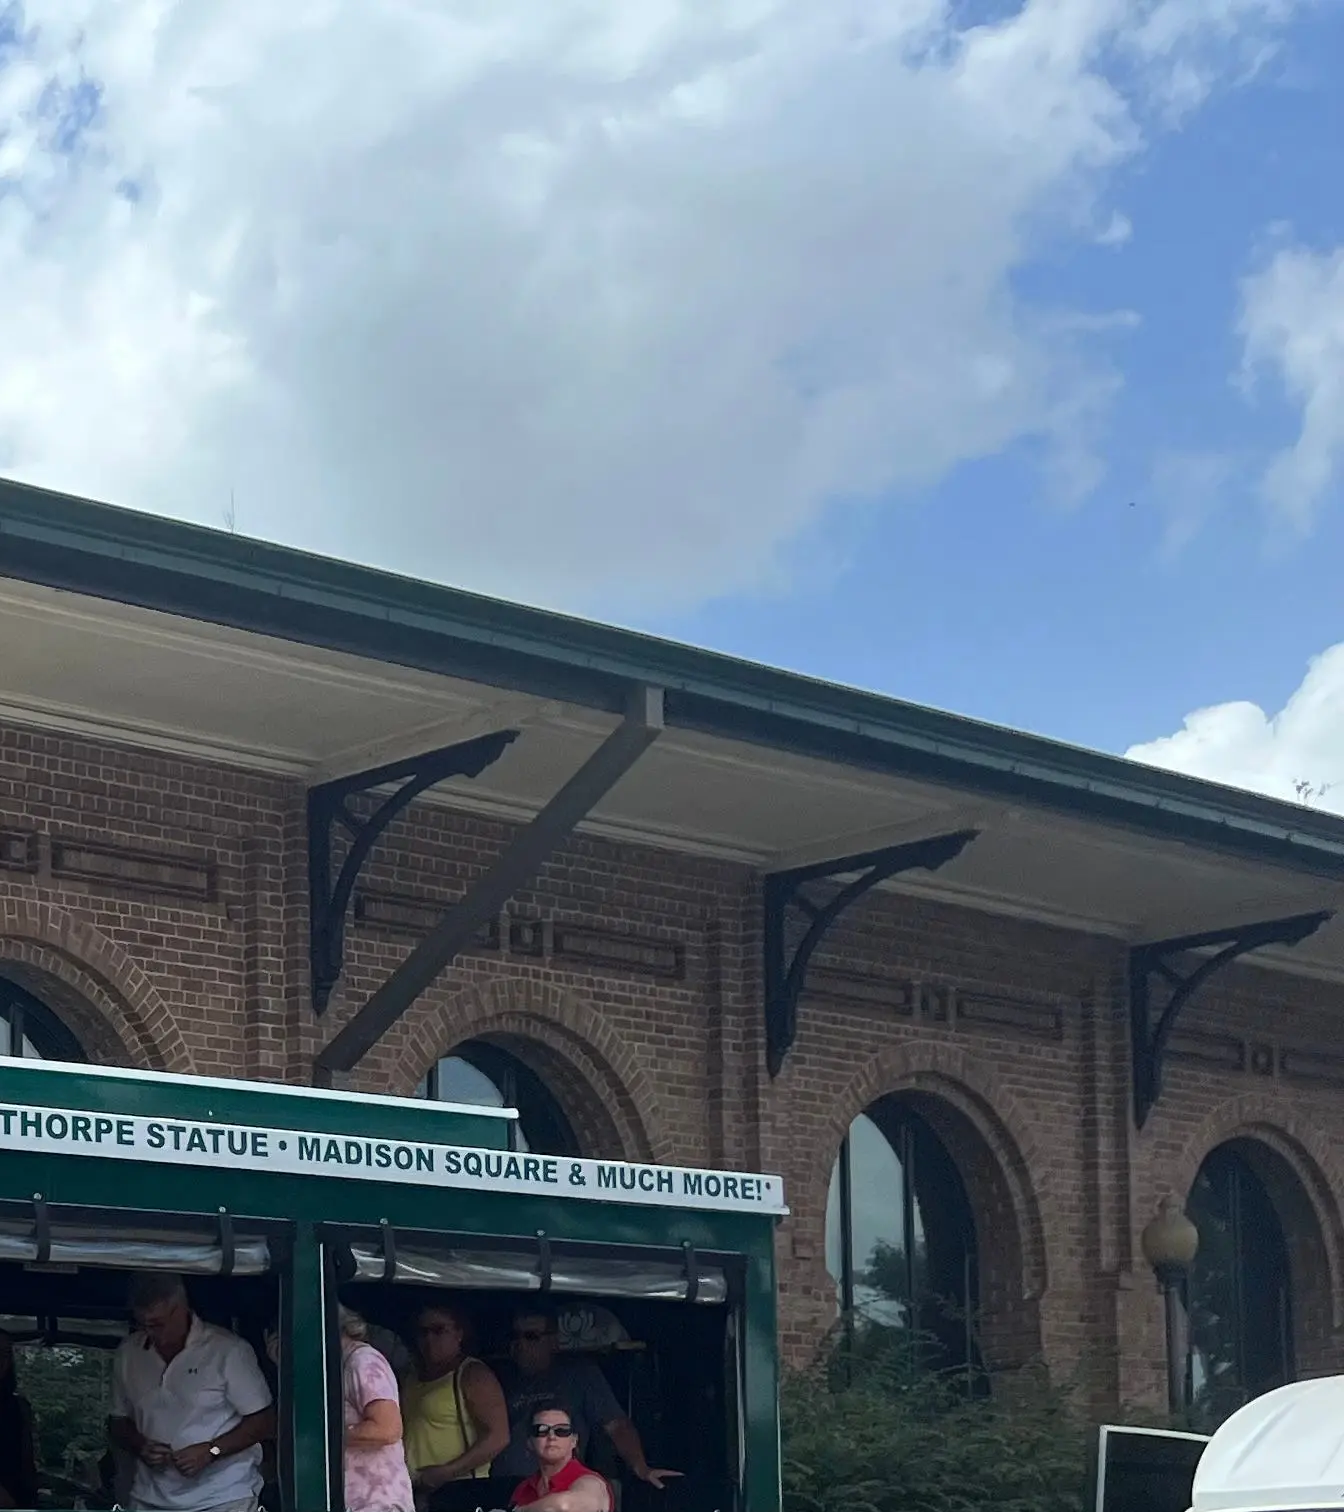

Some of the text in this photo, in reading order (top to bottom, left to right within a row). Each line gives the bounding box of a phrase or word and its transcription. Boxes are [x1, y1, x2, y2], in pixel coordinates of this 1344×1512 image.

[146, 1123, 269, 1158] STATUE
[298, 1136, 434, 1172] MADISON
[444, 1150, 559, 1184] SQUARE
[568, 1163, 586, 1187] &
[596, 1165, 674, 1195] MUCH
[682, 1172, 763, 1201] MORE!
